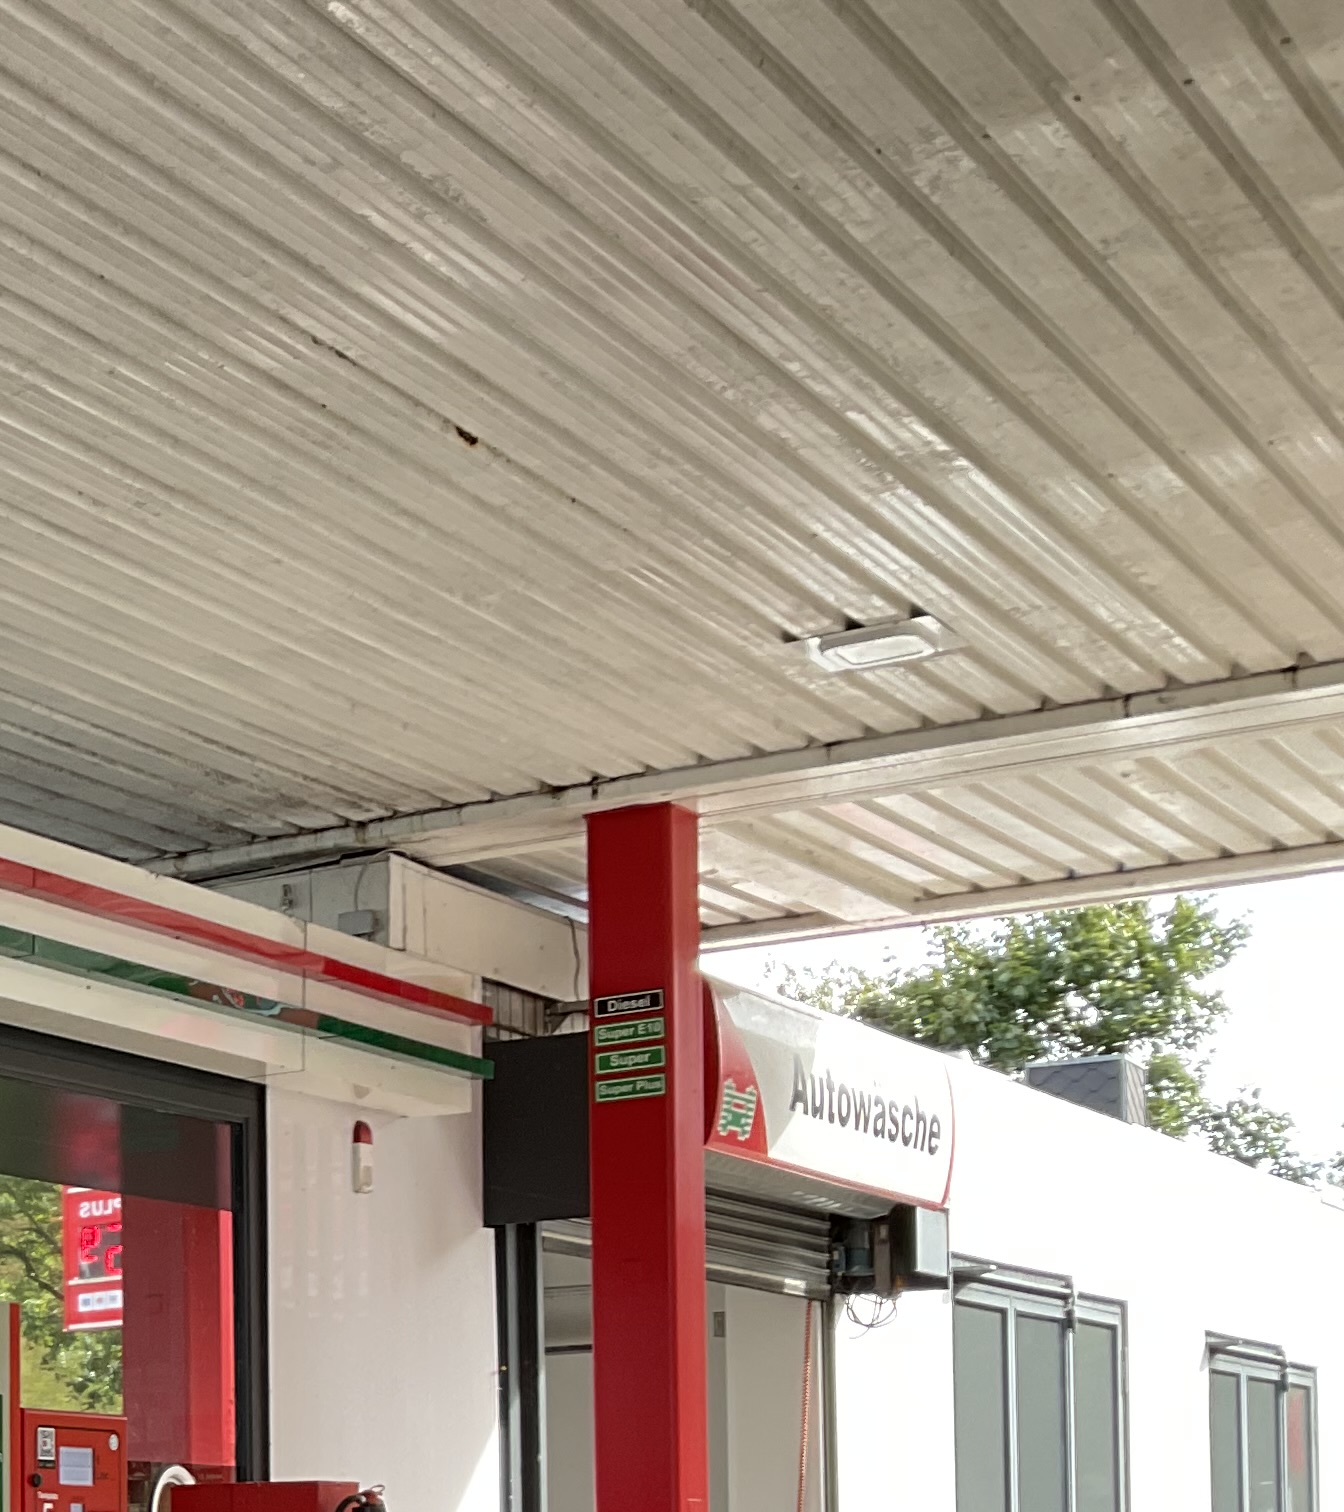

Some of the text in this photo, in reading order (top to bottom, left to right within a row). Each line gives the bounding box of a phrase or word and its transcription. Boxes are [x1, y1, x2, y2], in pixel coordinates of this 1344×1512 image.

[607, 995, 652, 1013] Diesel
[598, 1022, 662, 1041] Super E10
[609, 1052, 652, 1068] Super
[599, 1080, 662, 1096] Super Plus
[789, 1053, 942, 1156] Autowäsche
